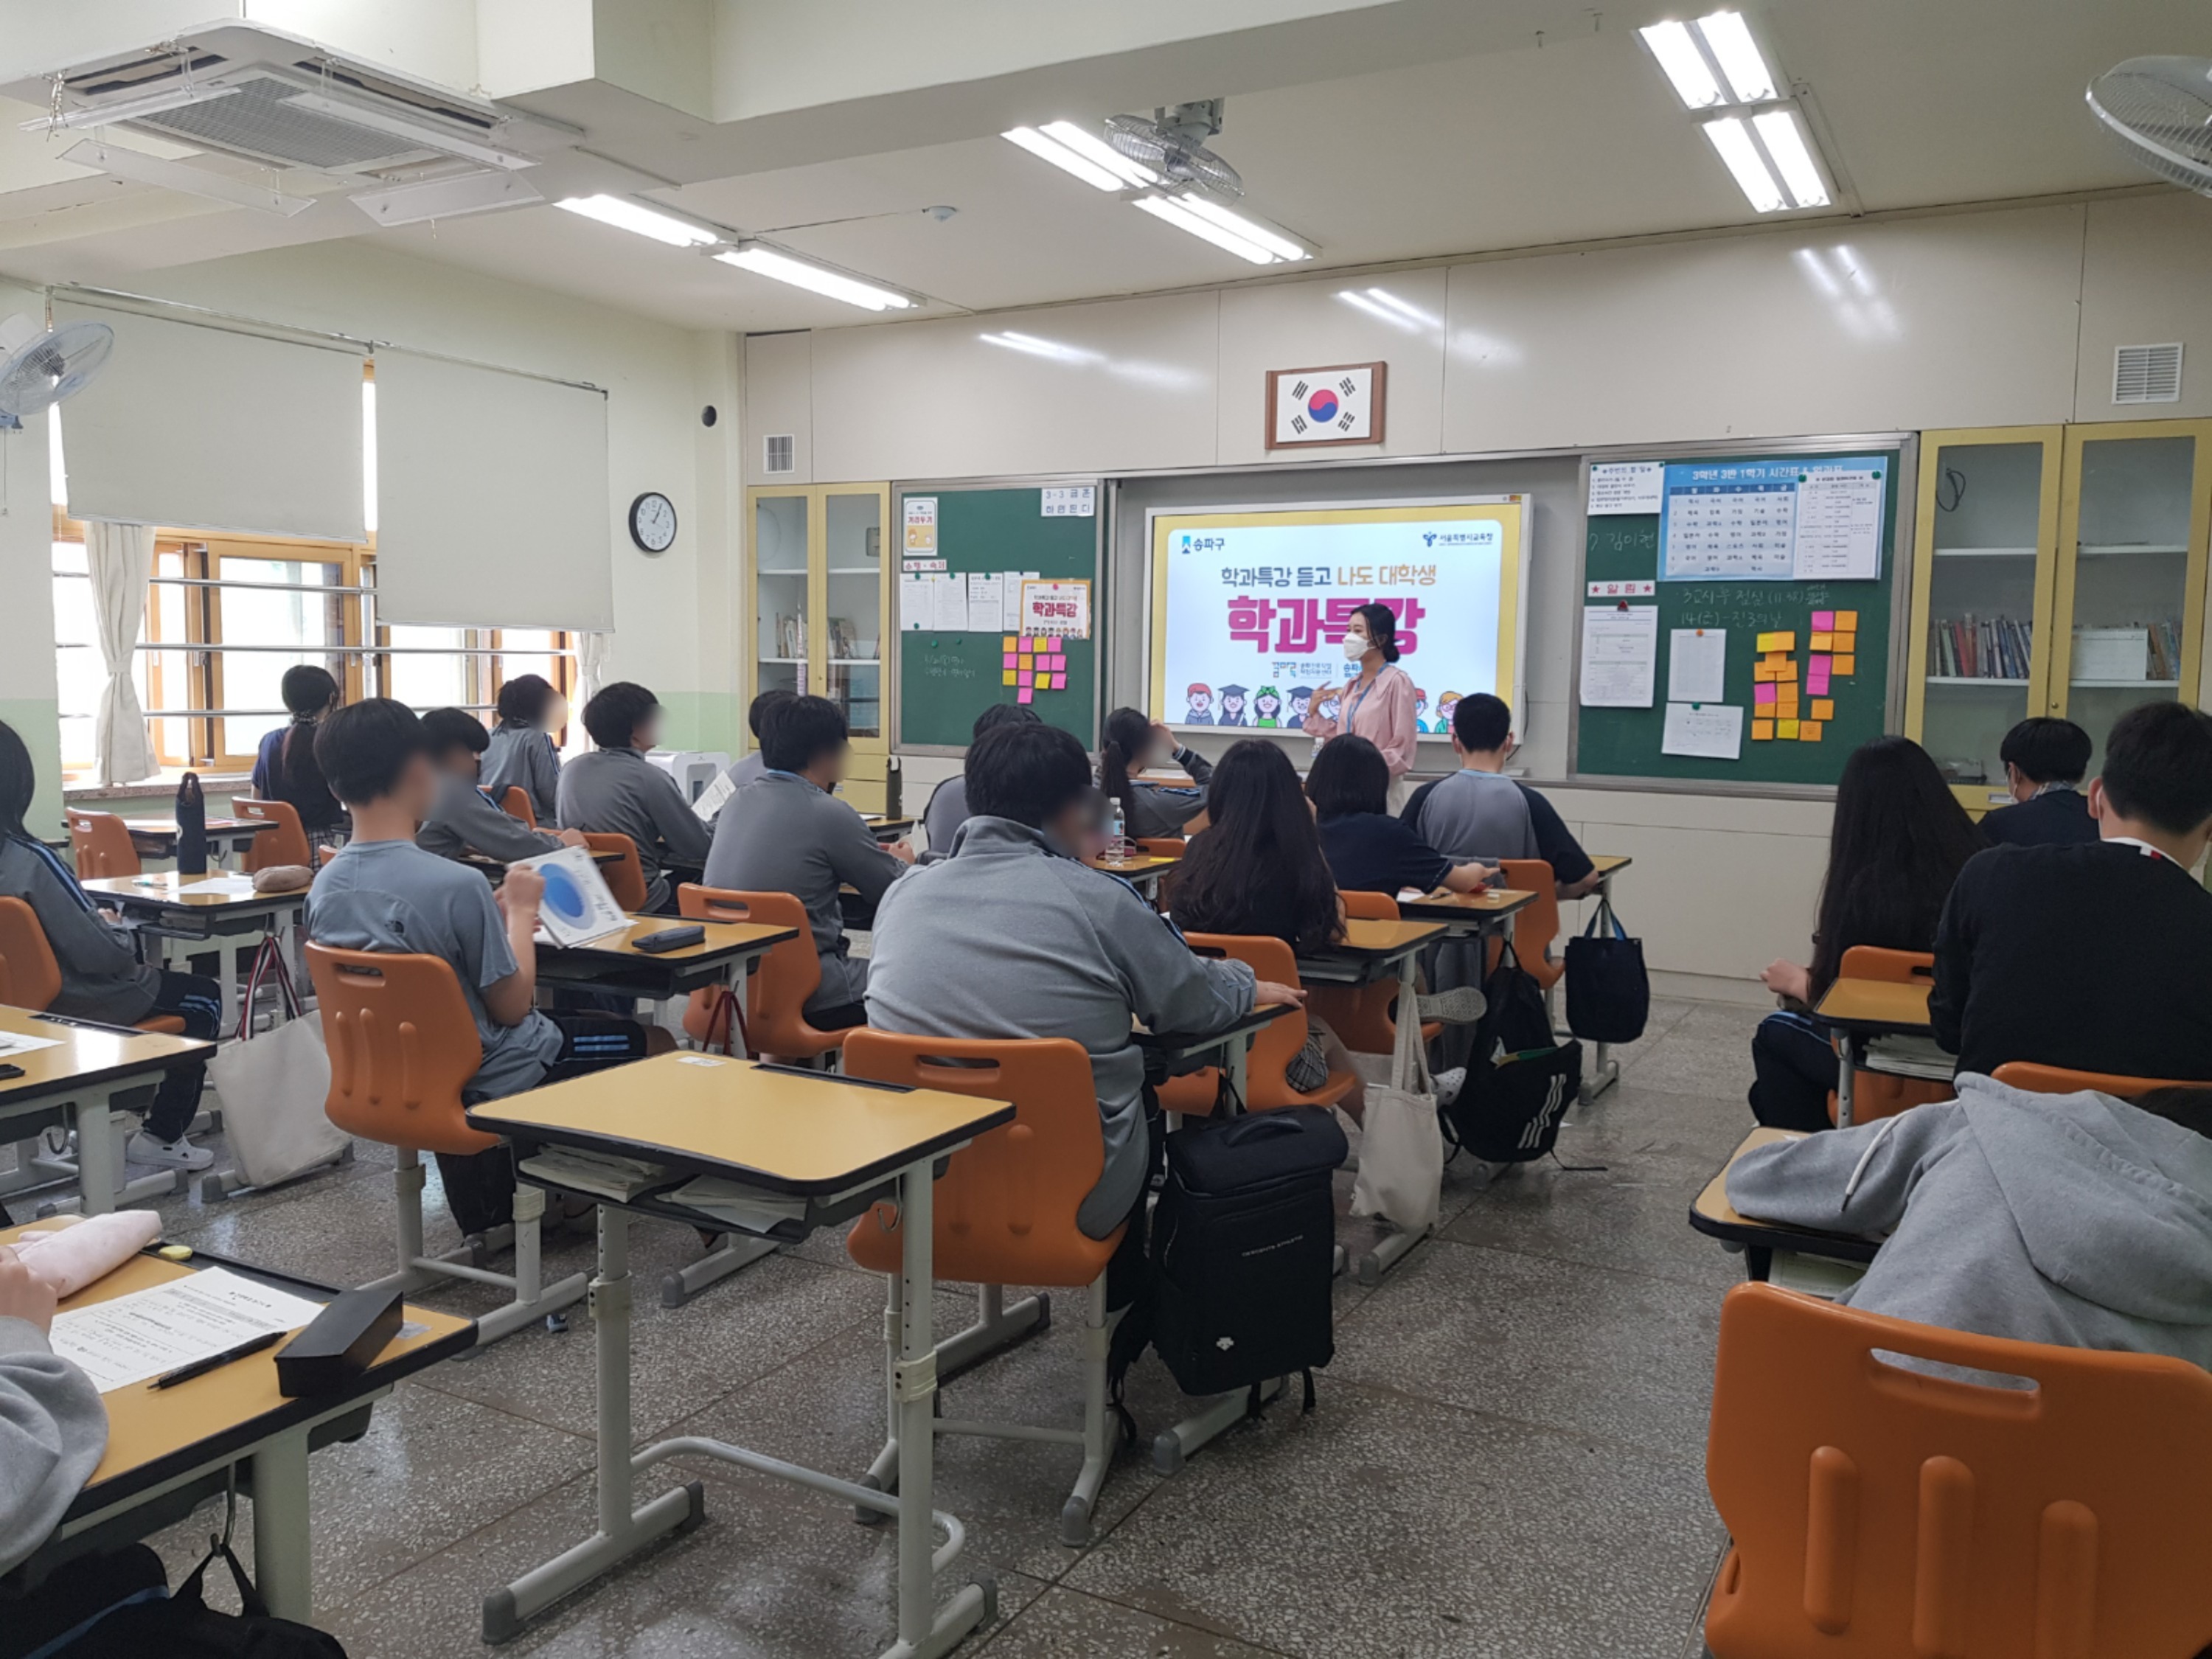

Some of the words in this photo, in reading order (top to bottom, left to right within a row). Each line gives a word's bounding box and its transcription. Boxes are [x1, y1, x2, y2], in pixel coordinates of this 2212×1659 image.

[1692, 470, 1718, 480] 3학년
[1721, 469, 1736, 479] 3반
[1740, 468, 1765, 479] 1학기
[1769, 467, 1799, 478] 시간표
[1193, 537, 1225, 553] 송파구
[1440, 533, 1493, 543] 서울특별시교육청
[1221, 566, 1293, 588] 학과특강
[1297, 566, 1332, 587] 듣고
[1337, 565, 1374, 586] 나도
[1379, 564, 1437, 586] 대학생
